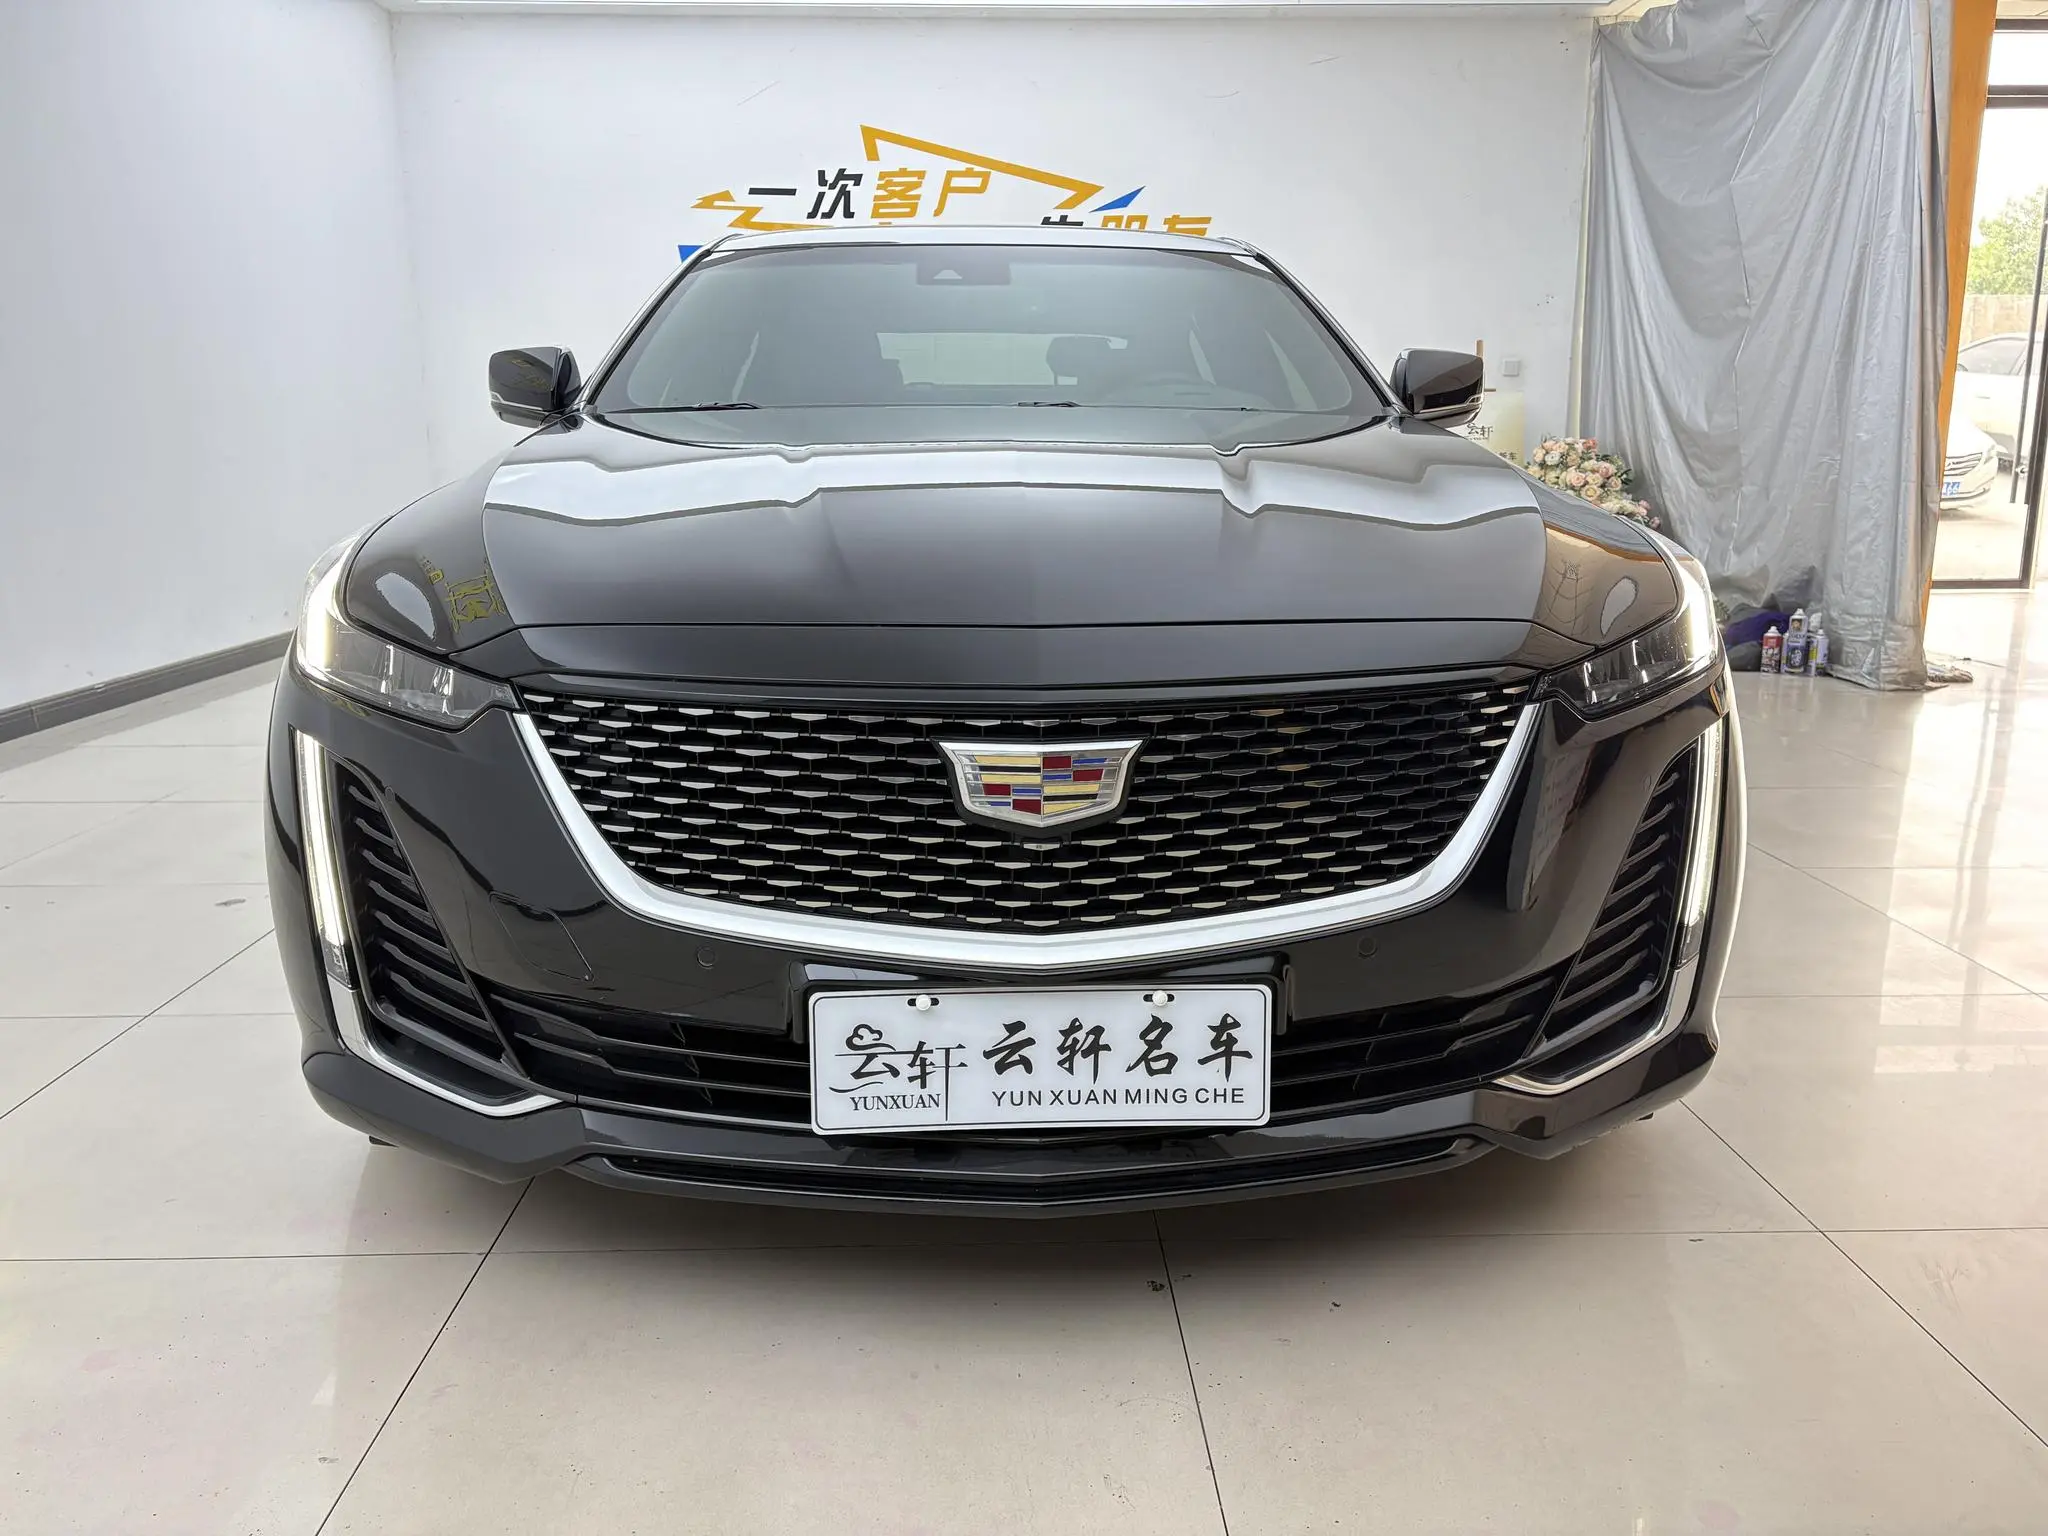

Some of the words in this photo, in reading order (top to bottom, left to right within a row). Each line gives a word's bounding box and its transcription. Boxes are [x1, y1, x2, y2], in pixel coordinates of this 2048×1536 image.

[748, 168, 991, 219] 一次客户
[835, 1024, 968, 1121] 云轩
[983, 1013, 1253, 1084] 云轩名车
[850, 1093, 941, 1111] YUNXUAN
[992, 1091, 1042, 1106] YUN
[1049, 1089, 1117, 1106] XUAN
[1125, 1088, 1188, 1105] MING
[1195, 1088, 1245, 1104] CHE
